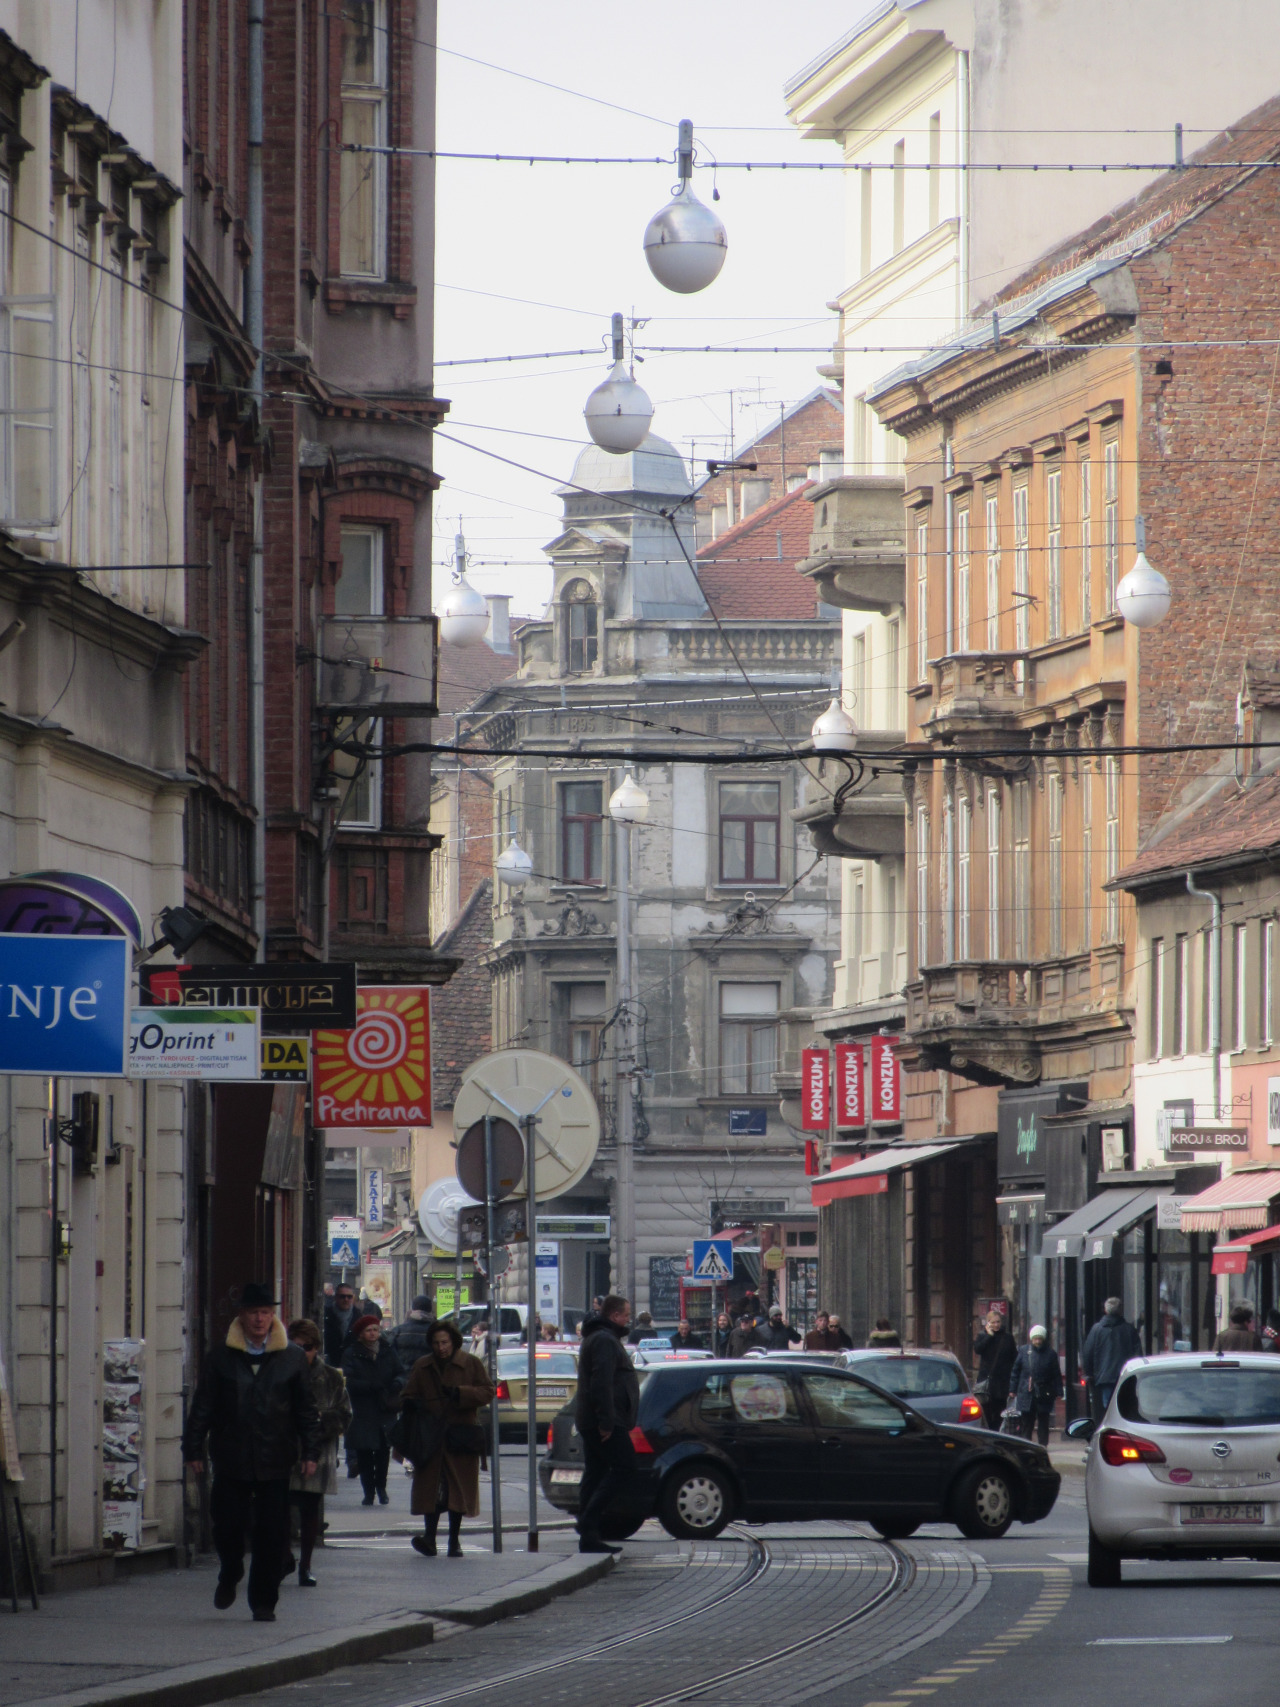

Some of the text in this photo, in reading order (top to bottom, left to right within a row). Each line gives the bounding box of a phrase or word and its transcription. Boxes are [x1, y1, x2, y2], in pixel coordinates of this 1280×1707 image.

[811, 1057, 824, 1121] KONZUM
[845, 1052, 859, 1117] KONZUM
[880, 1044, 894, 1111] KONZUM
[318, 1095, 427, 1122] Prehrana
[1171, 1133, 1247, 1146] KROJ & BROJ
[369, 1170, 379, 1222] ZLATAR
[1257, 1472, 1271, 1480] HR
